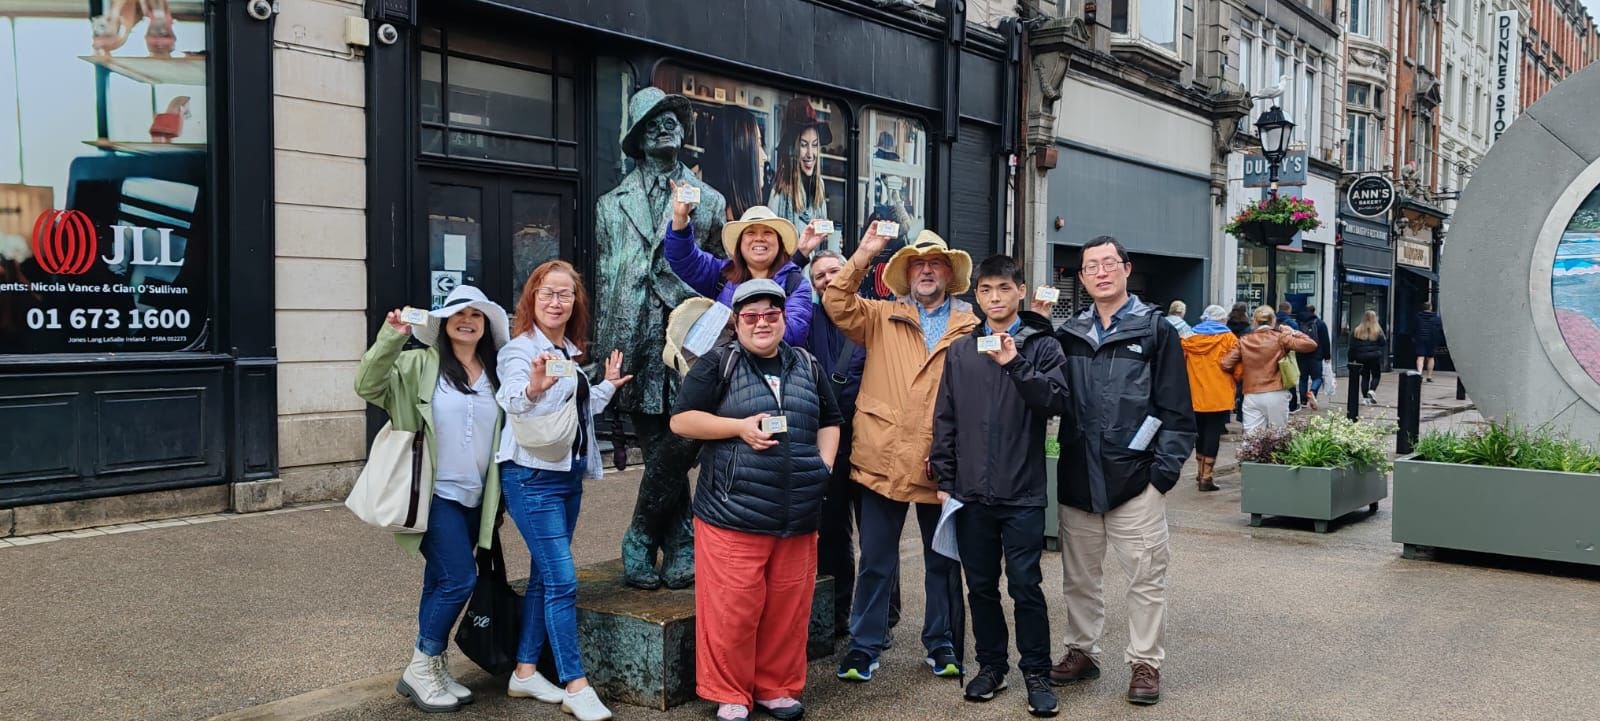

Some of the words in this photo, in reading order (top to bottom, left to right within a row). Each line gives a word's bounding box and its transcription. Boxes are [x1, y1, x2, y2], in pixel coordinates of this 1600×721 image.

[1498, 15, 1511, 90] DUNNES
[1245, 156, 1302, 175] DUFY'S
[1352, 188, 1390, 200] ANN'S
[101, 224, 185, 266] JLL
[0, 282, 28, 293] ents:
[31, 282, 66, 292] Nicola
[68, 283, 101, 293] Vance
[102, 284, 111, 293] &
[112, 284, 135, 293] Cian
[137, 284, 188, 294] O'Sullivan
[26, 307, 62, 330] 01
[69, 307, 120, 330] 673
[128, 308, 191, 329] 1600
